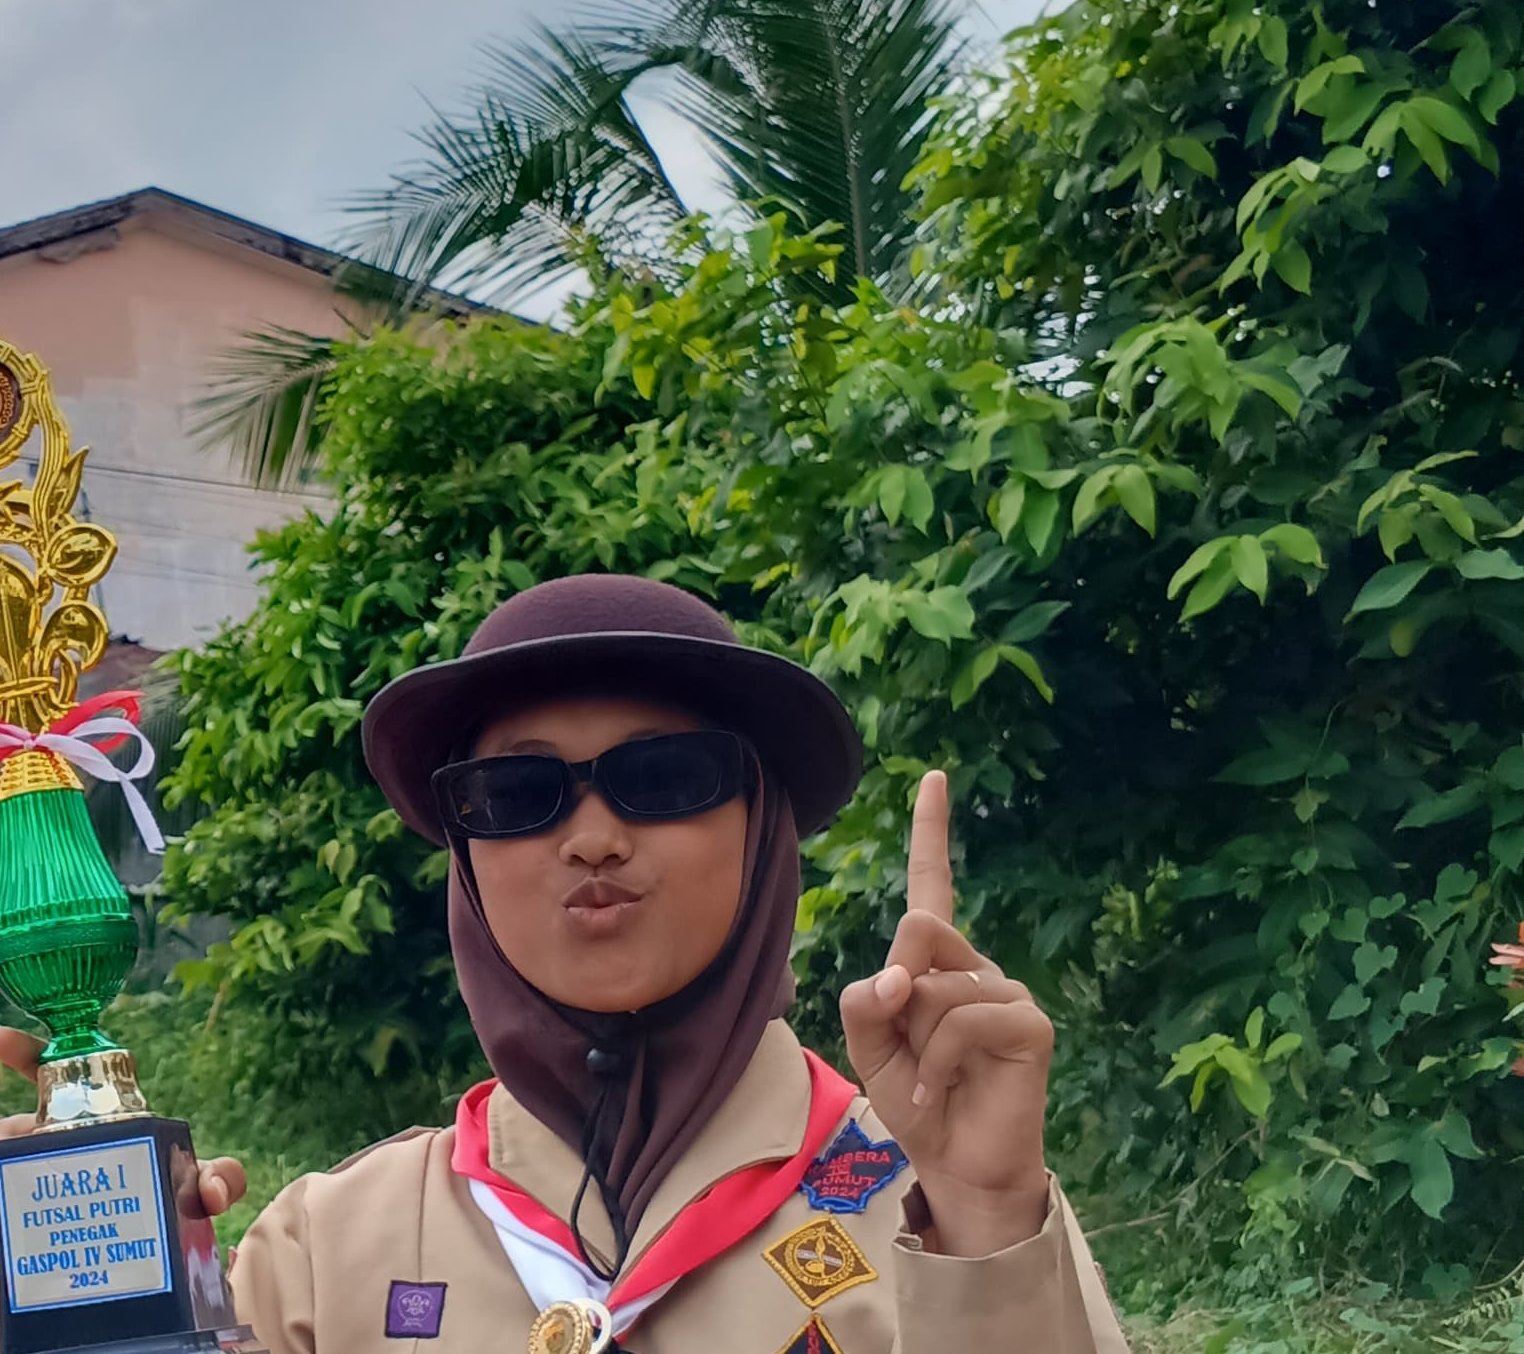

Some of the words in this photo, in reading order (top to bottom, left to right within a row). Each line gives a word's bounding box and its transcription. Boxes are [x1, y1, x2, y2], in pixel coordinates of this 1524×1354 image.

[32, 1167, 112, 1201] JUARA
[117, 1164, 127, 1189] I
[23, 1205, 85, 1229] FUTSAL
[89, 1197, 140, 1218] PUTRI
[49, 1223, 119, 1246] PENEGAK
[17, 1249, 80, 1275] GASPOL
[84, 1245, 101, 1267] IV
[106, 1238, 157, 1263] SUMUT
[69, 1270, 109, 1289] 2024
